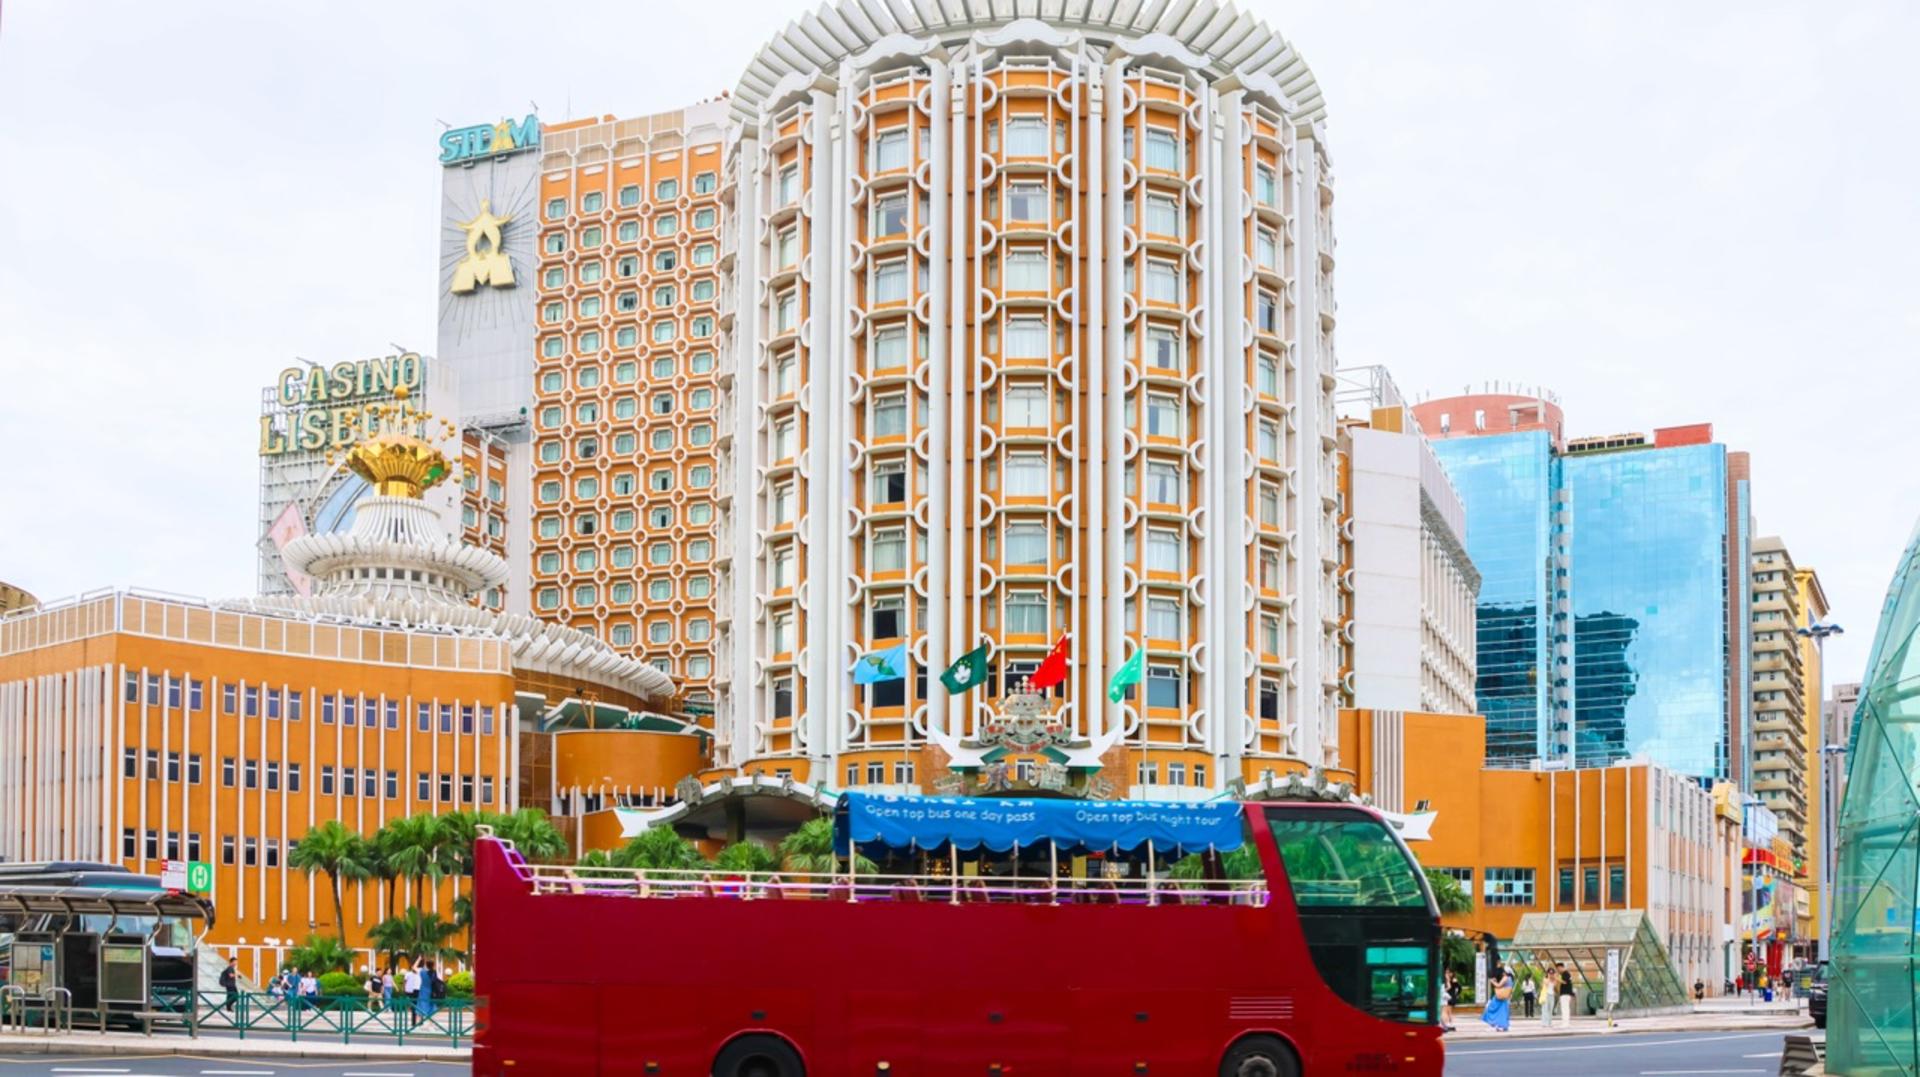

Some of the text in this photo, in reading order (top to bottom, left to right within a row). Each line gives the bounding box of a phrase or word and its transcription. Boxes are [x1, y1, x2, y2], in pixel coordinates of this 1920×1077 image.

[278, 352, 421, 406] CASINO
[865, 804, 1036, 824] Open top bus one day pass
[1075, 810, 1222, 827] Open top bus night tour
